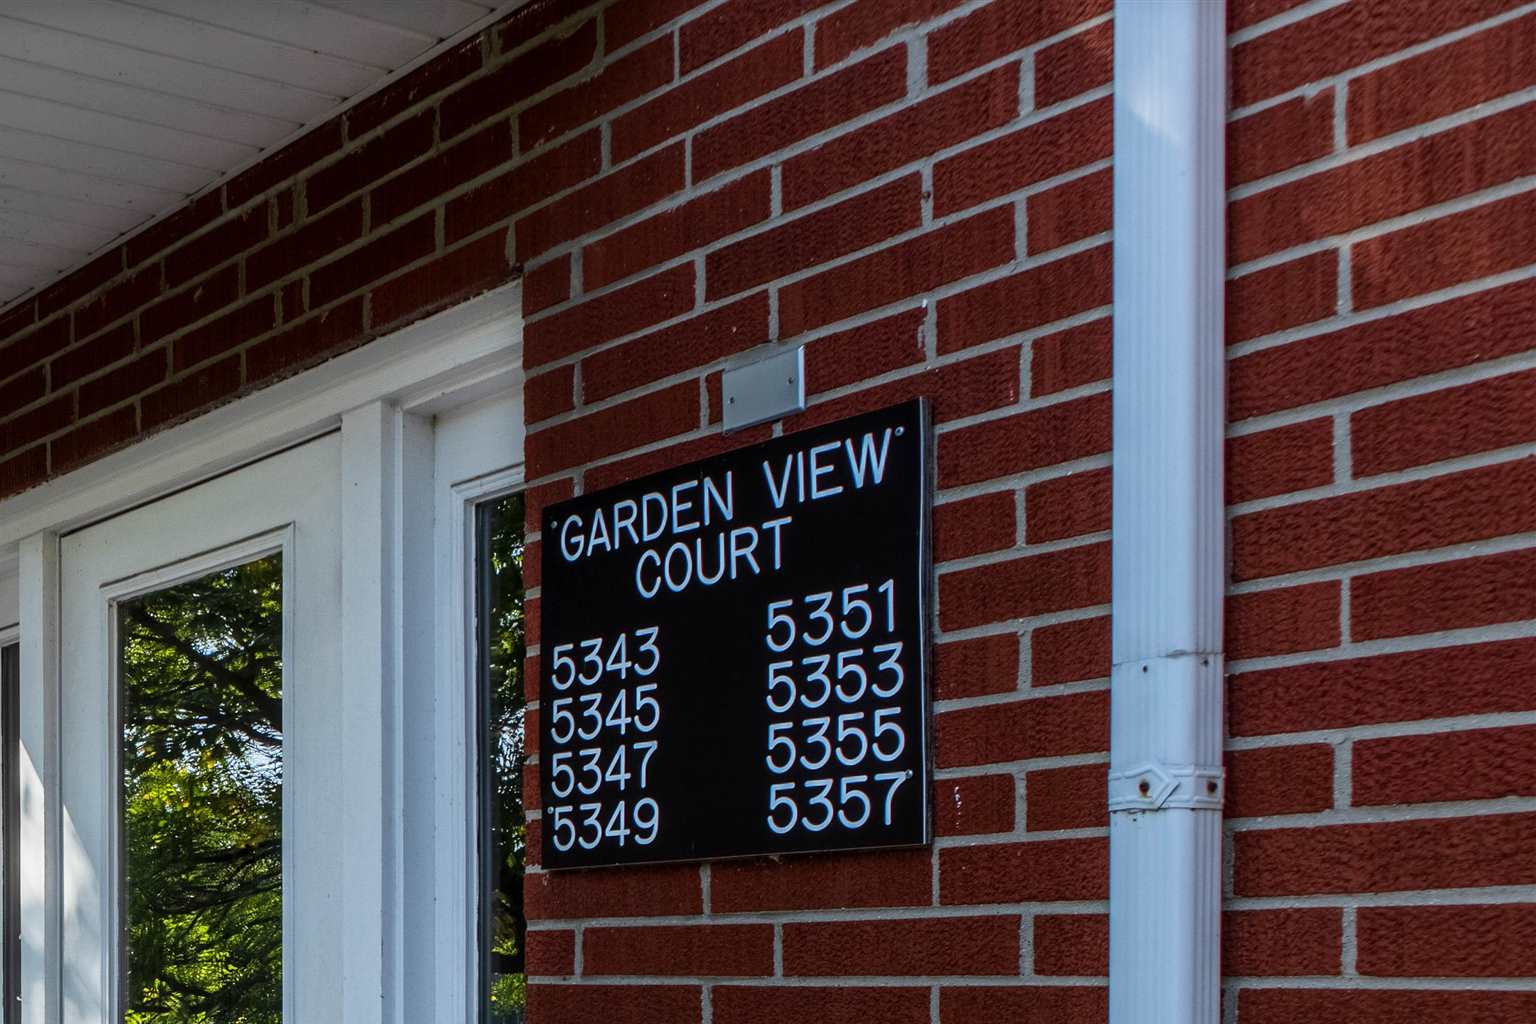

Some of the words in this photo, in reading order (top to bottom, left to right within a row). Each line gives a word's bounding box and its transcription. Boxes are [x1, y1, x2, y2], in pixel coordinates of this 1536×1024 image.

[560, 470, 734, 563] GARDEN
[762, 426, 894, 509] VIEW
[635, 515, 794, 600] COURT
[765, 578, 896, 653] 5351
[550, 625, 661, 692] 5343
[765, 640, 905, 715] 5353
[550, 683, 661, 745] 5345
[765, 706, 906, 775] 5355
[550, 740, 659, 799] 5347
[766, 770, 907, 835] 5357
[552, 796, 661, 853] 5349
